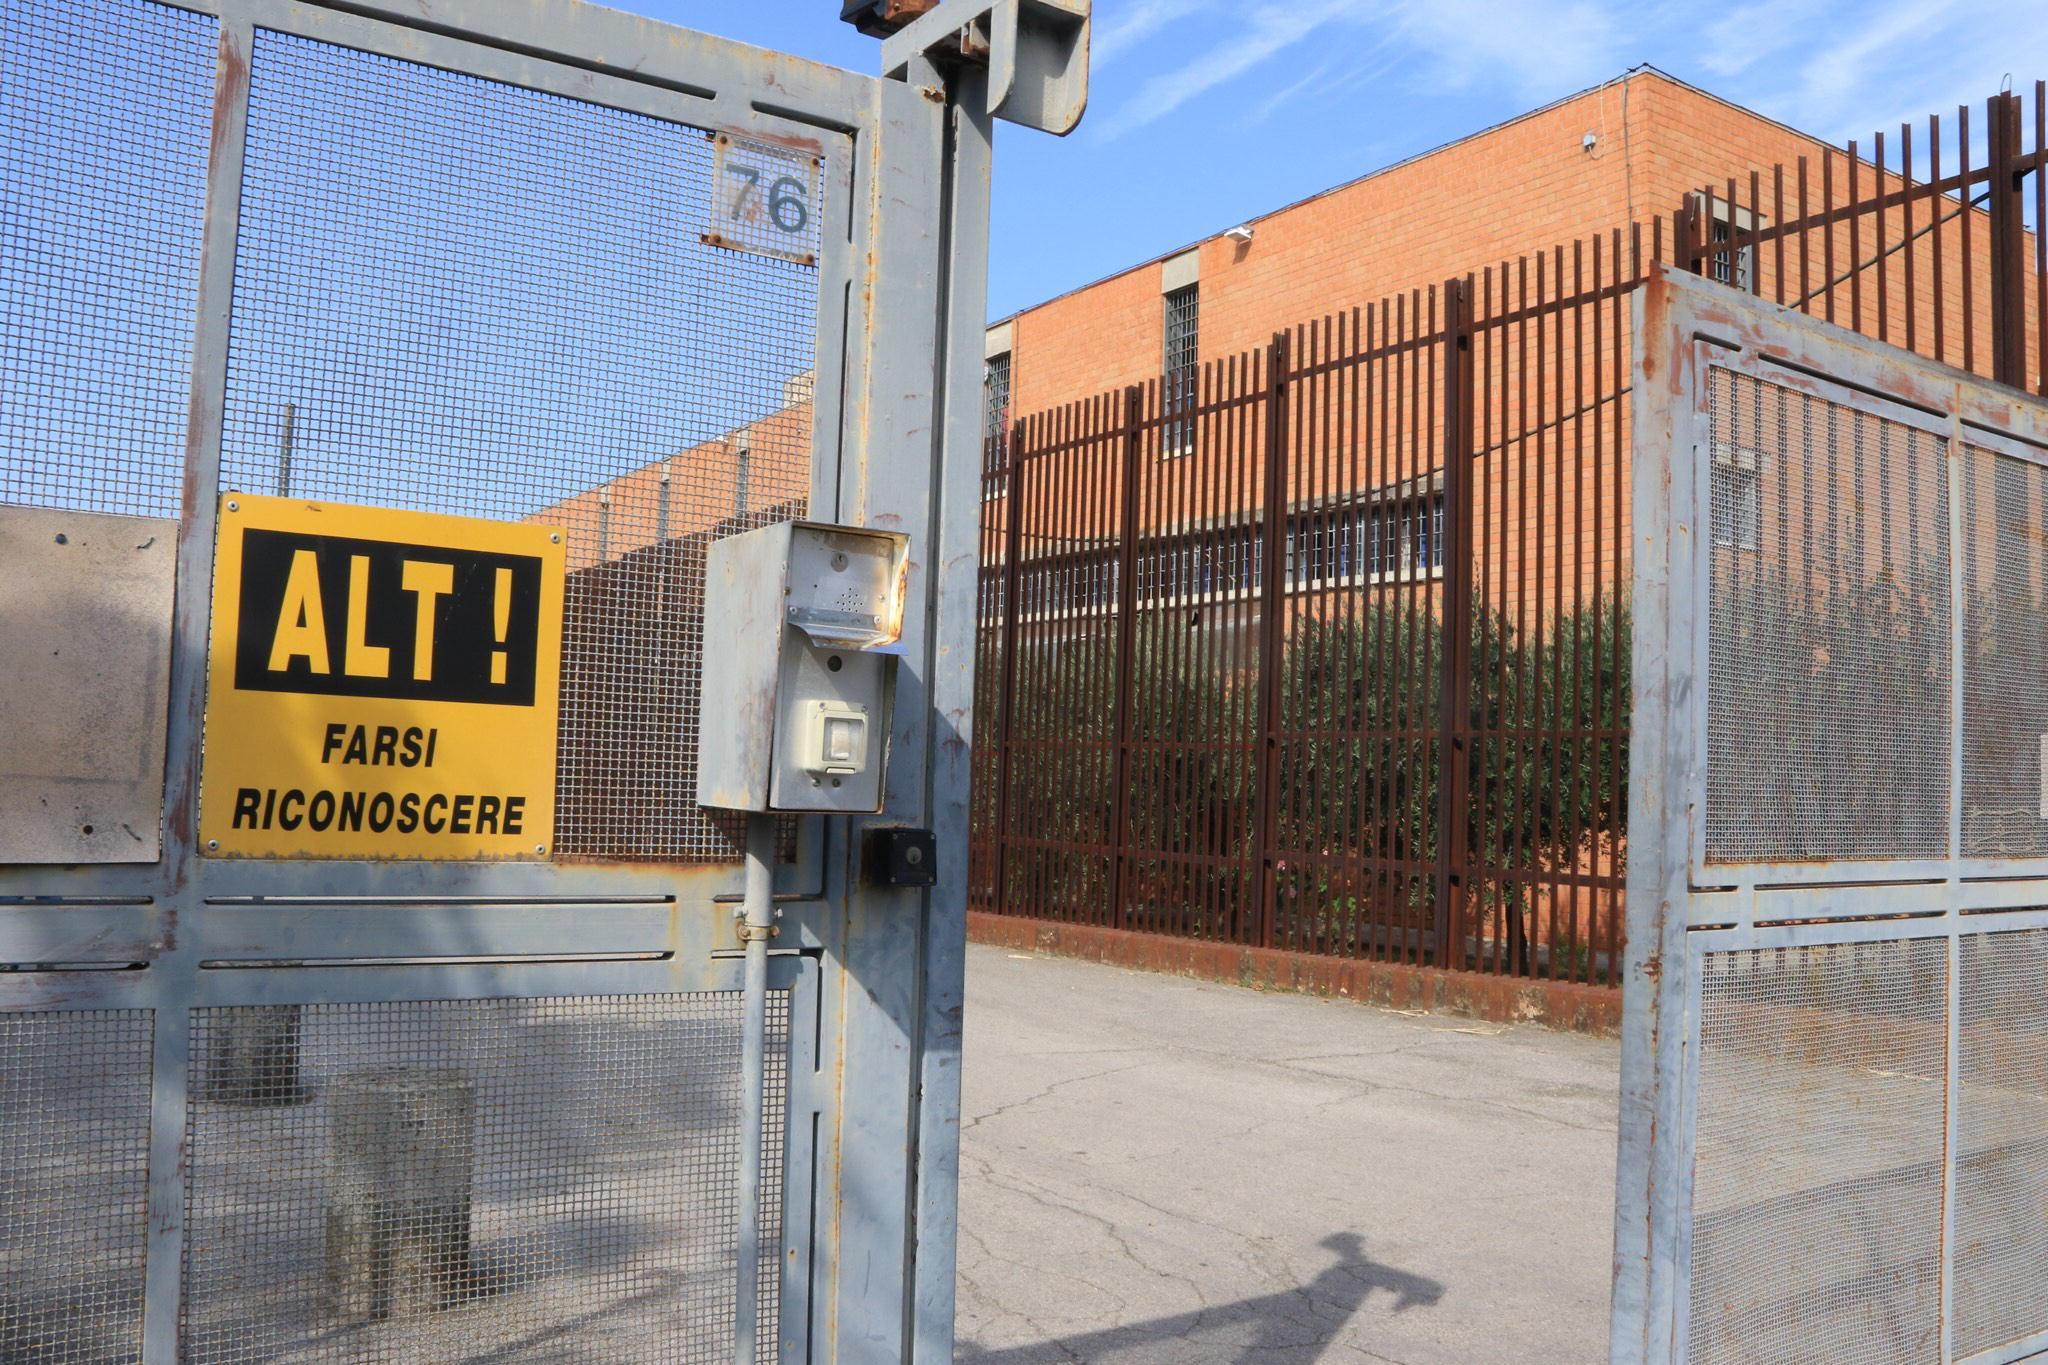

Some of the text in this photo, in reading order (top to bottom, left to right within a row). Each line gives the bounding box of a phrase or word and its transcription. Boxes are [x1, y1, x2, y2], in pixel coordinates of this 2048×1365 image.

[726, 163, 807, 233] 76
[321, 723, 438, 767] FARSI
[232, 788, 526, 835] RICONOSCERE
